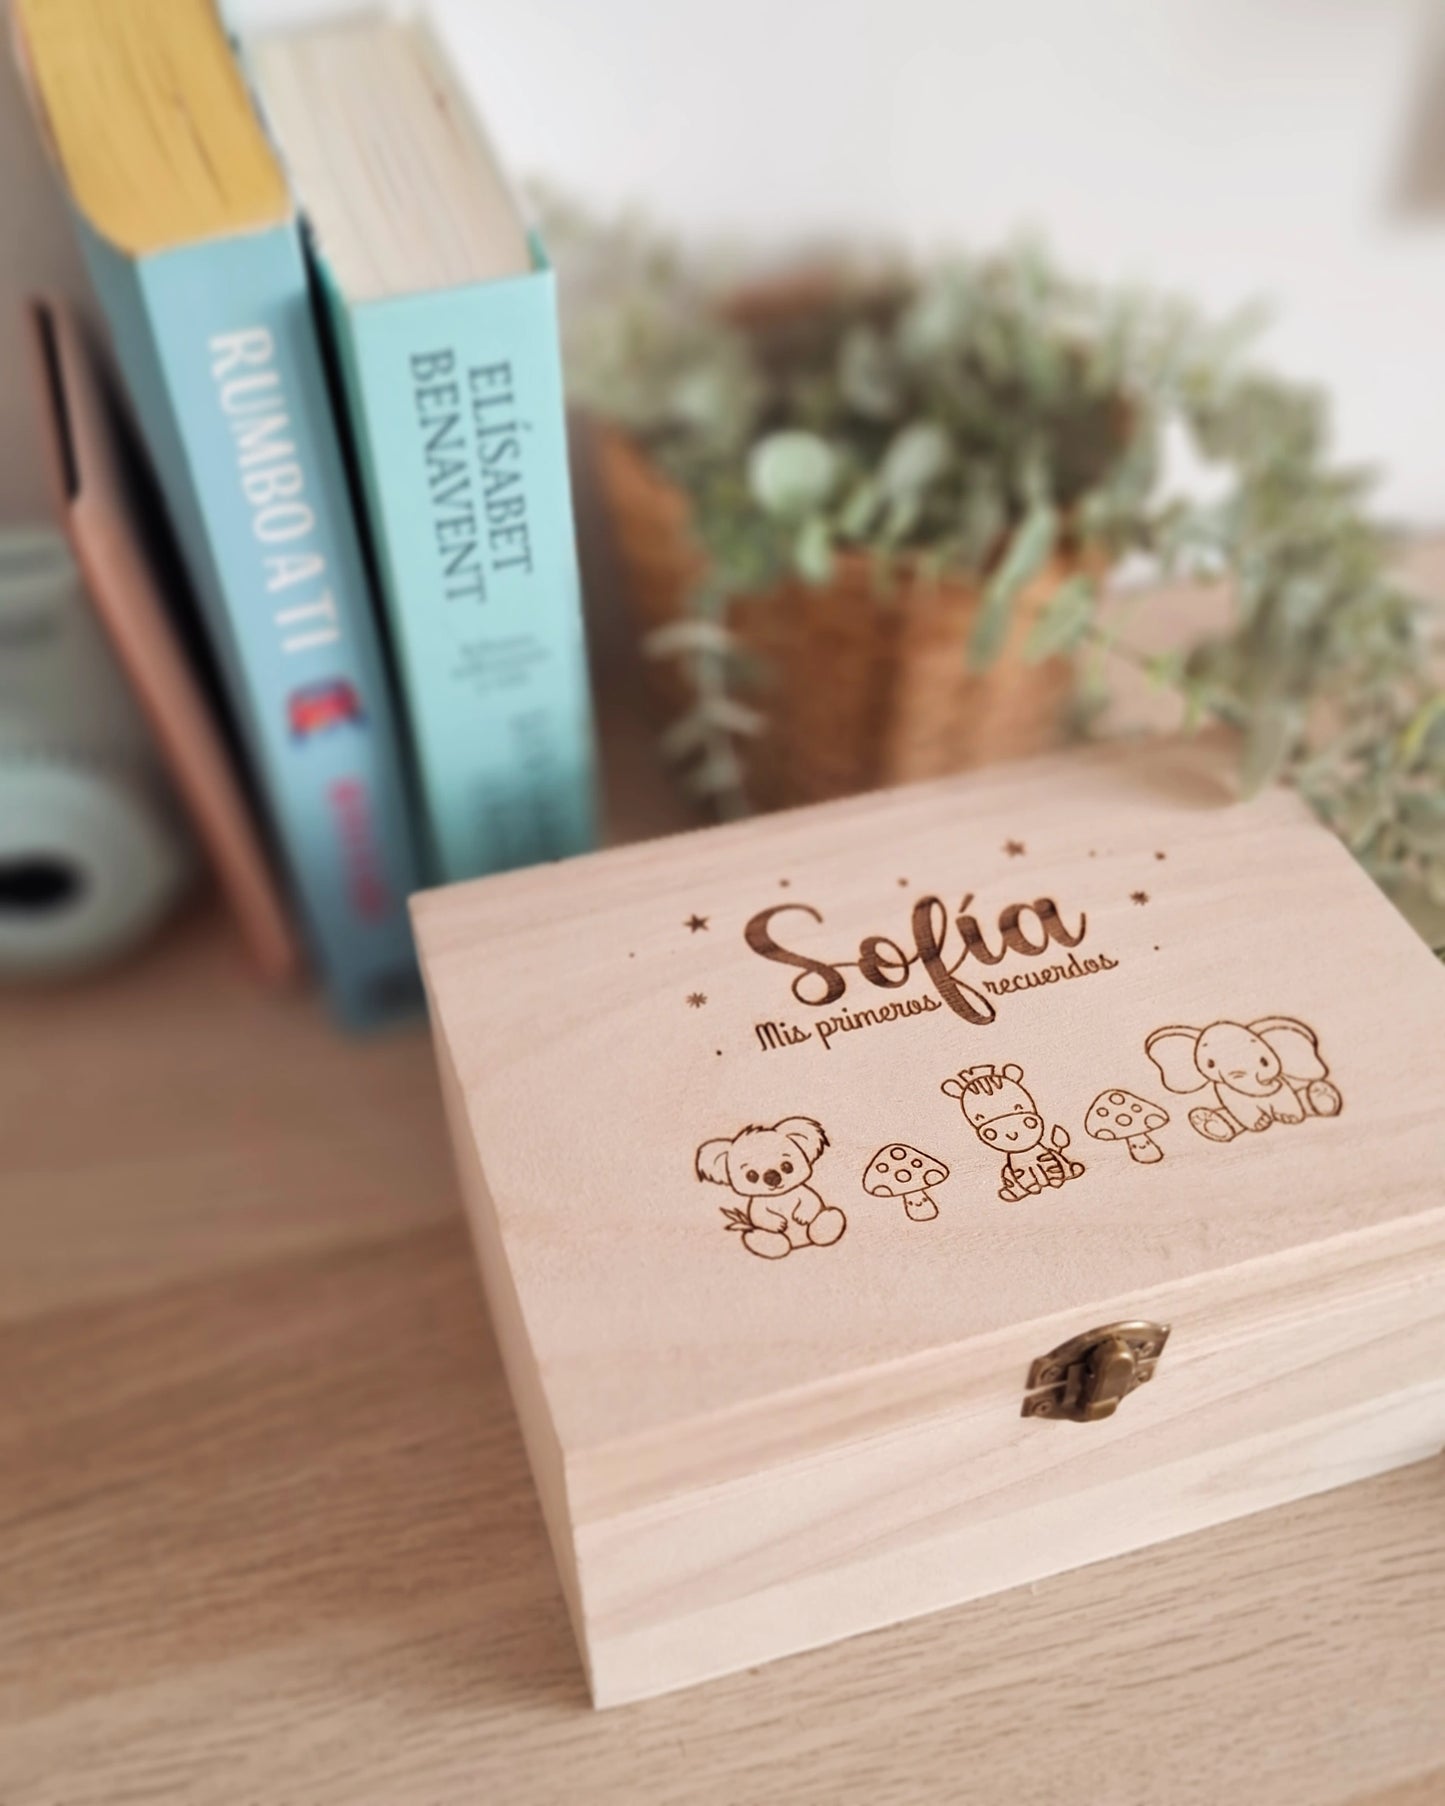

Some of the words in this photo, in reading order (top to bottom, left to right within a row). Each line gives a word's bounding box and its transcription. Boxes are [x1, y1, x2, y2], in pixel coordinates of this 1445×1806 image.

[209, 325, 316, 544] RUMBO
[410, 346, 488, 605] BENAVENT
[468, 359, 534, 577] ELÍSABET
[263, 549, 326, 595] A
[274, 586, 341, 655] TI
[744, 894, 1087, 1027] Sofía
[754, 1020, 813, 1052] Mis
[814, 994, 943, 1051] primeros
[981, 953, 1120, 997] recuerdos
